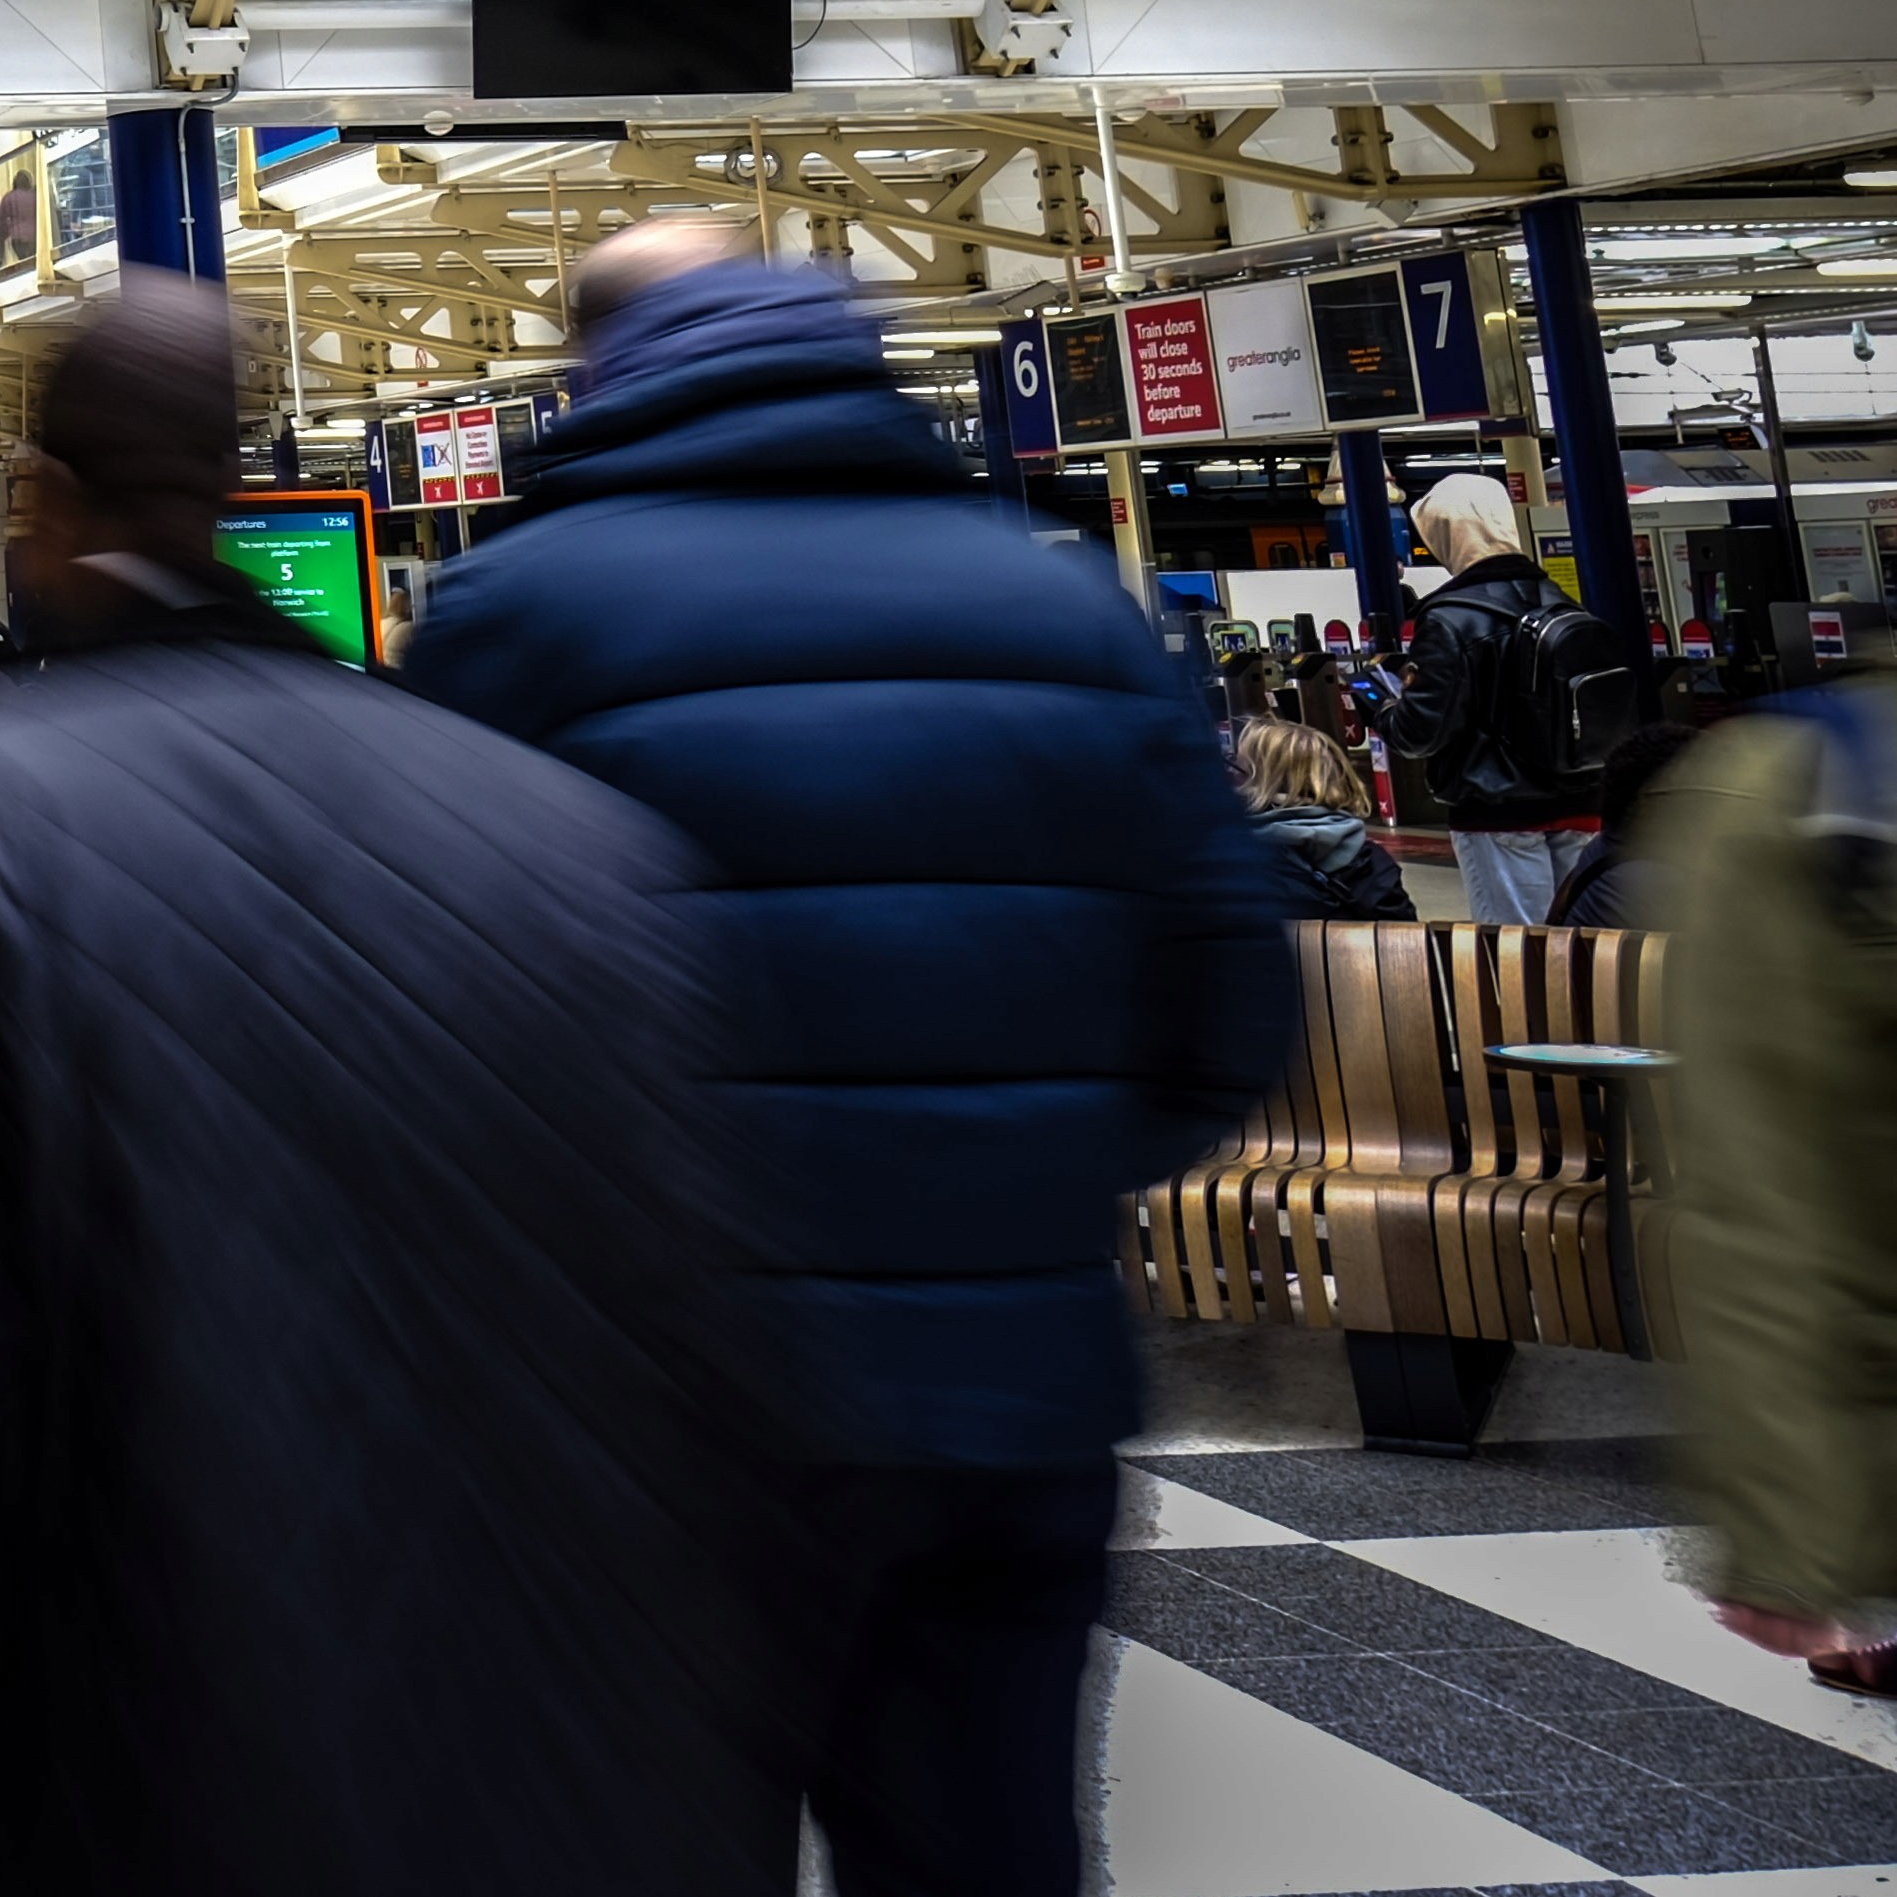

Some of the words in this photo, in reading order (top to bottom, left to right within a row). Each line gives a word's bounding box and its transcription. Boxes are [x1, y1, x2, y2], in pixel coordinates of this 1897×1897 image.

[1421, 280, 1451, 348] 7
[1135, 321, 1161, 339] Train
[1164, 319, 1196, 335] doors
[1138, 344, 1157, 359] will
[1160, 341, 1188, 357] close
[1227, 346, 1301, 372] greateranglia
[1013, 341, 1038, 398] 6
[1142, 364, 1154, 380] 30
[1158, 359, 1202, 379] seconds
[1145, 384, 1180, 401] before
[1148, 404, 1201, 424] departure
[370, 436, 382, 473] 4
[217, 521, 266, 530] Departures
[323, 517, 348, 526] 12:56
[281, 564, 293, 580] 5
